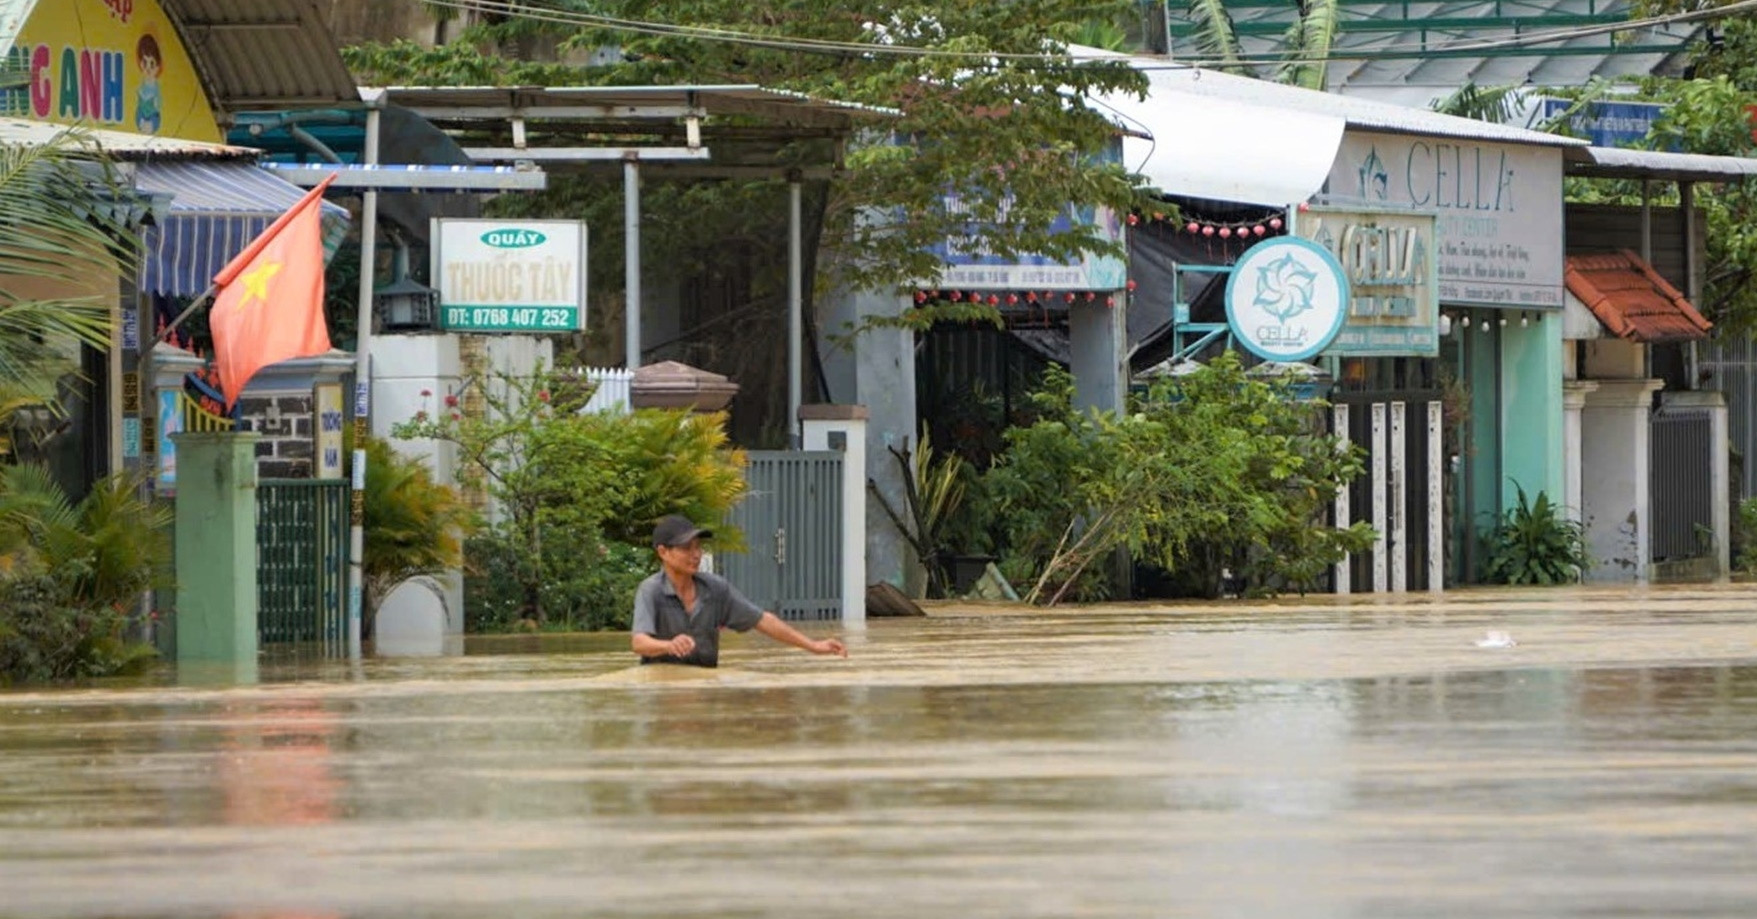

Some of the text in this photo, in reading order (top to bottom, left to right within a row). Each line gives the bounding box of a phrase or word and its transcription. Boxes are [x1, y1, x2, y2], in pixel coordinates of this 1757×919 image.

[59, 47, 123, 121] ANH
[1407, 140, 1514, 212] CELLA
[447, 250, 572, 301] THUỐC TÂY
[448, 308, 569, 327] ĐT: 0768 407 252
[1256, 325, 1308, 341] CELLA
